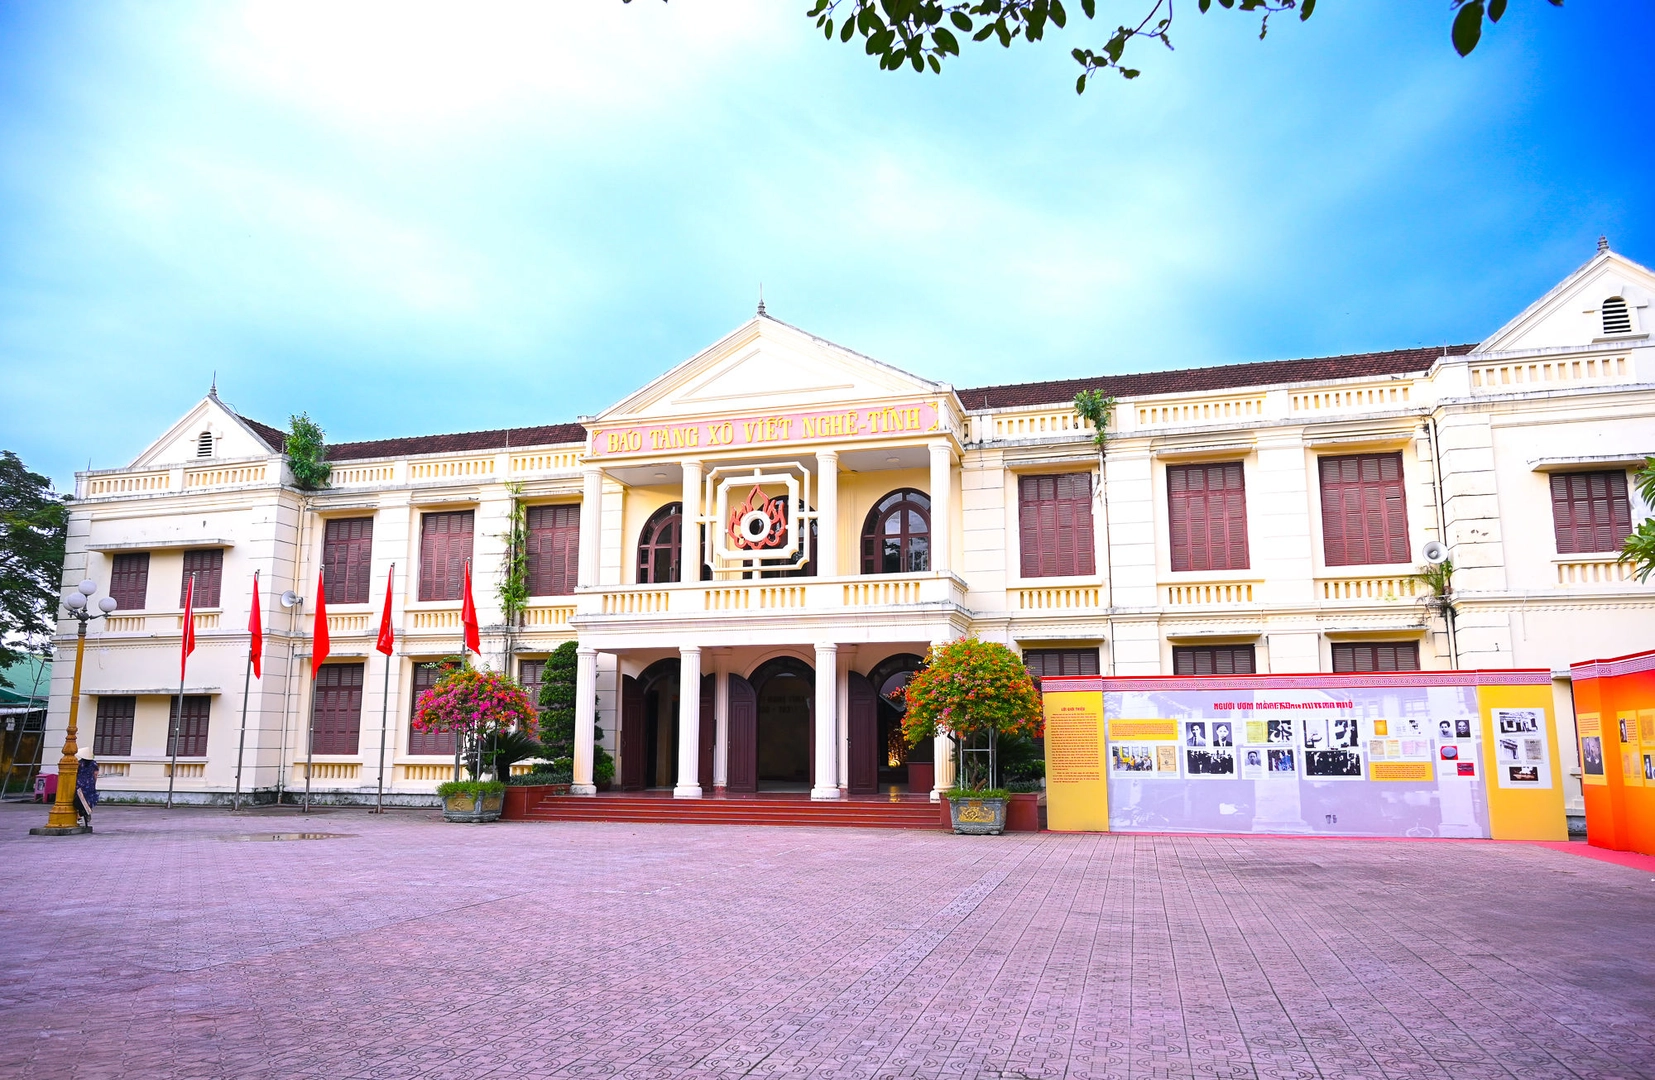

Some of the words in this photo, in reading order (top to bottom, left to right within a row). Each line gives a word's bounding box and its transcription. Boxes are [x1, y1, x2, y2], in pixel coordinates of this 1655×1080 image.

[607, 429, 642, 453] BẢO
[650, 425, 699, 450] TÀNG
[707, 422, 733, 446] XÔ
[743, 416, 792, 443] VIẾT
